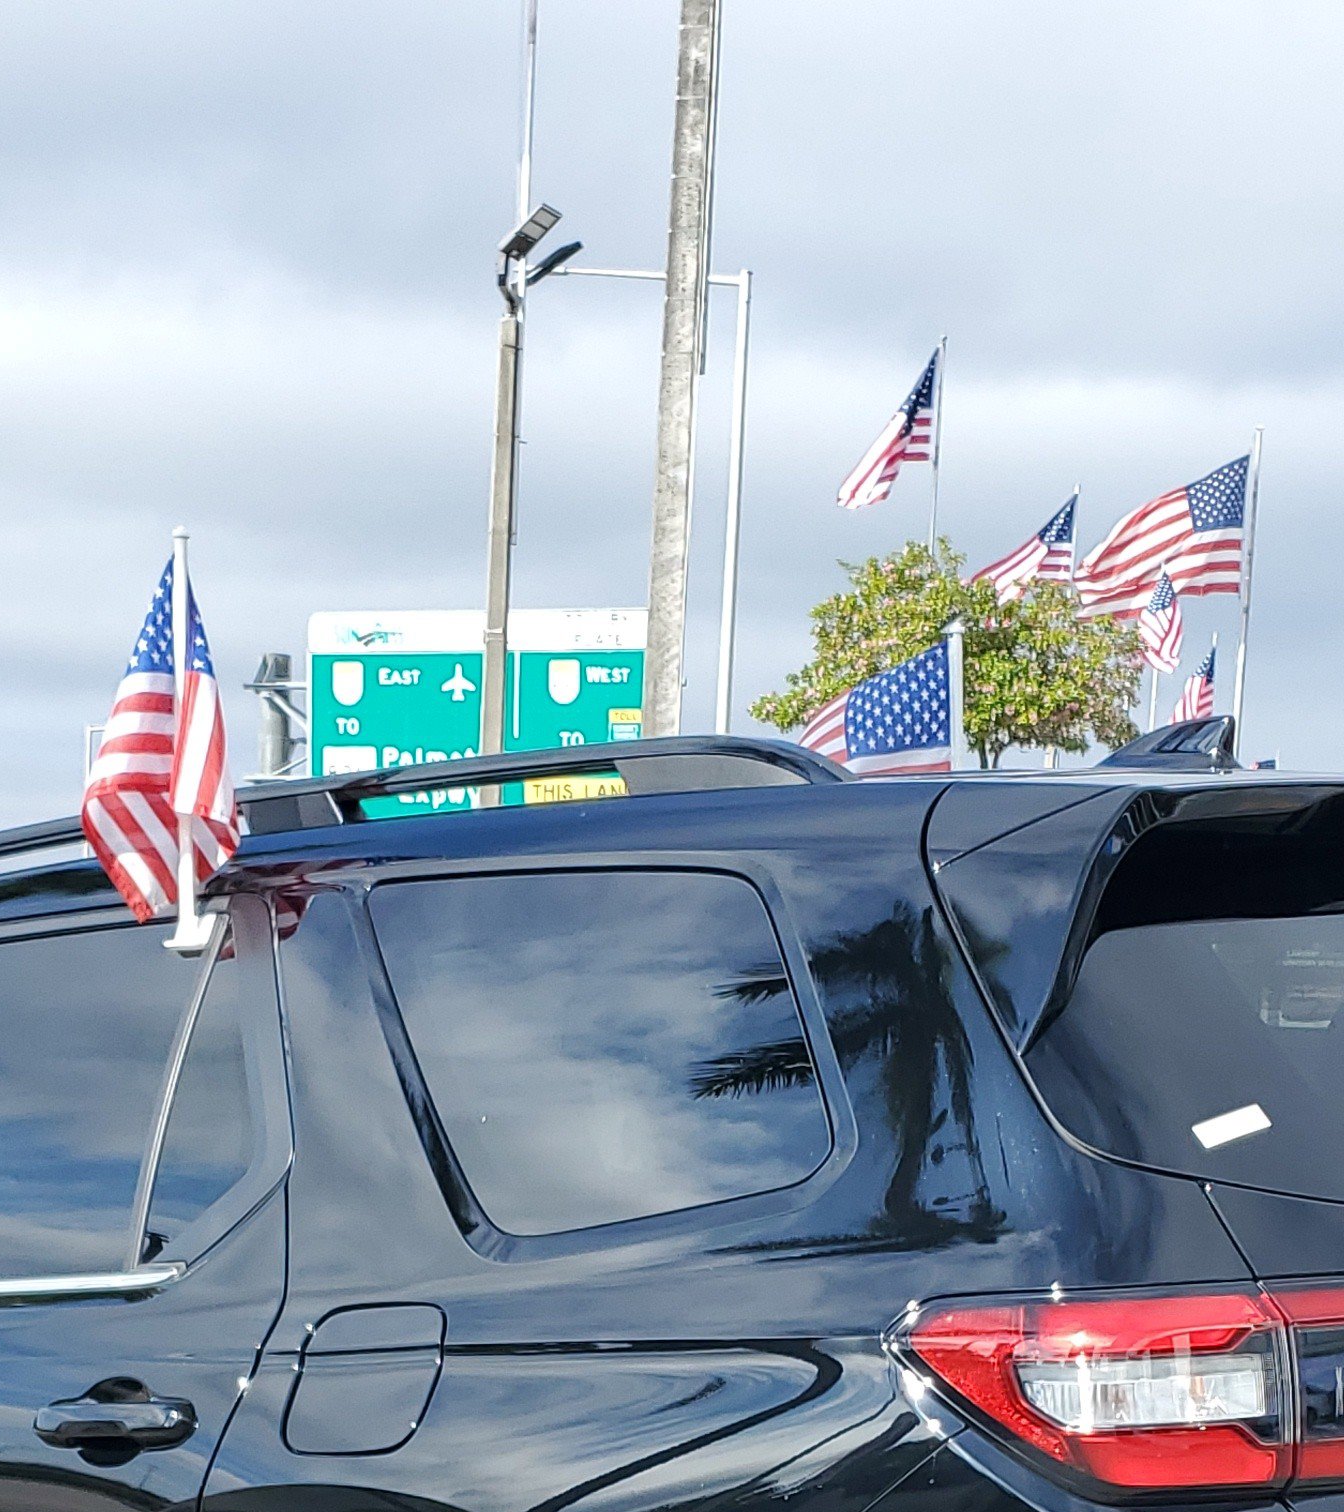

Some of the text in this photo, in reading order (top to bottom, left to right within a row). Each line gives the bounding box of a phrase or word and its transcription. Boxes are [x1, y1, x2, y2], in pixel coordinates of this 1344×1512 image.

[378, 667, 422, 686] EAST
[585, 666, 631, 684] WEST
[335, 717, 360, 735] TO
[558, 731, 585, 747] TO
[532, 784, 629, 801] THIS LAN
